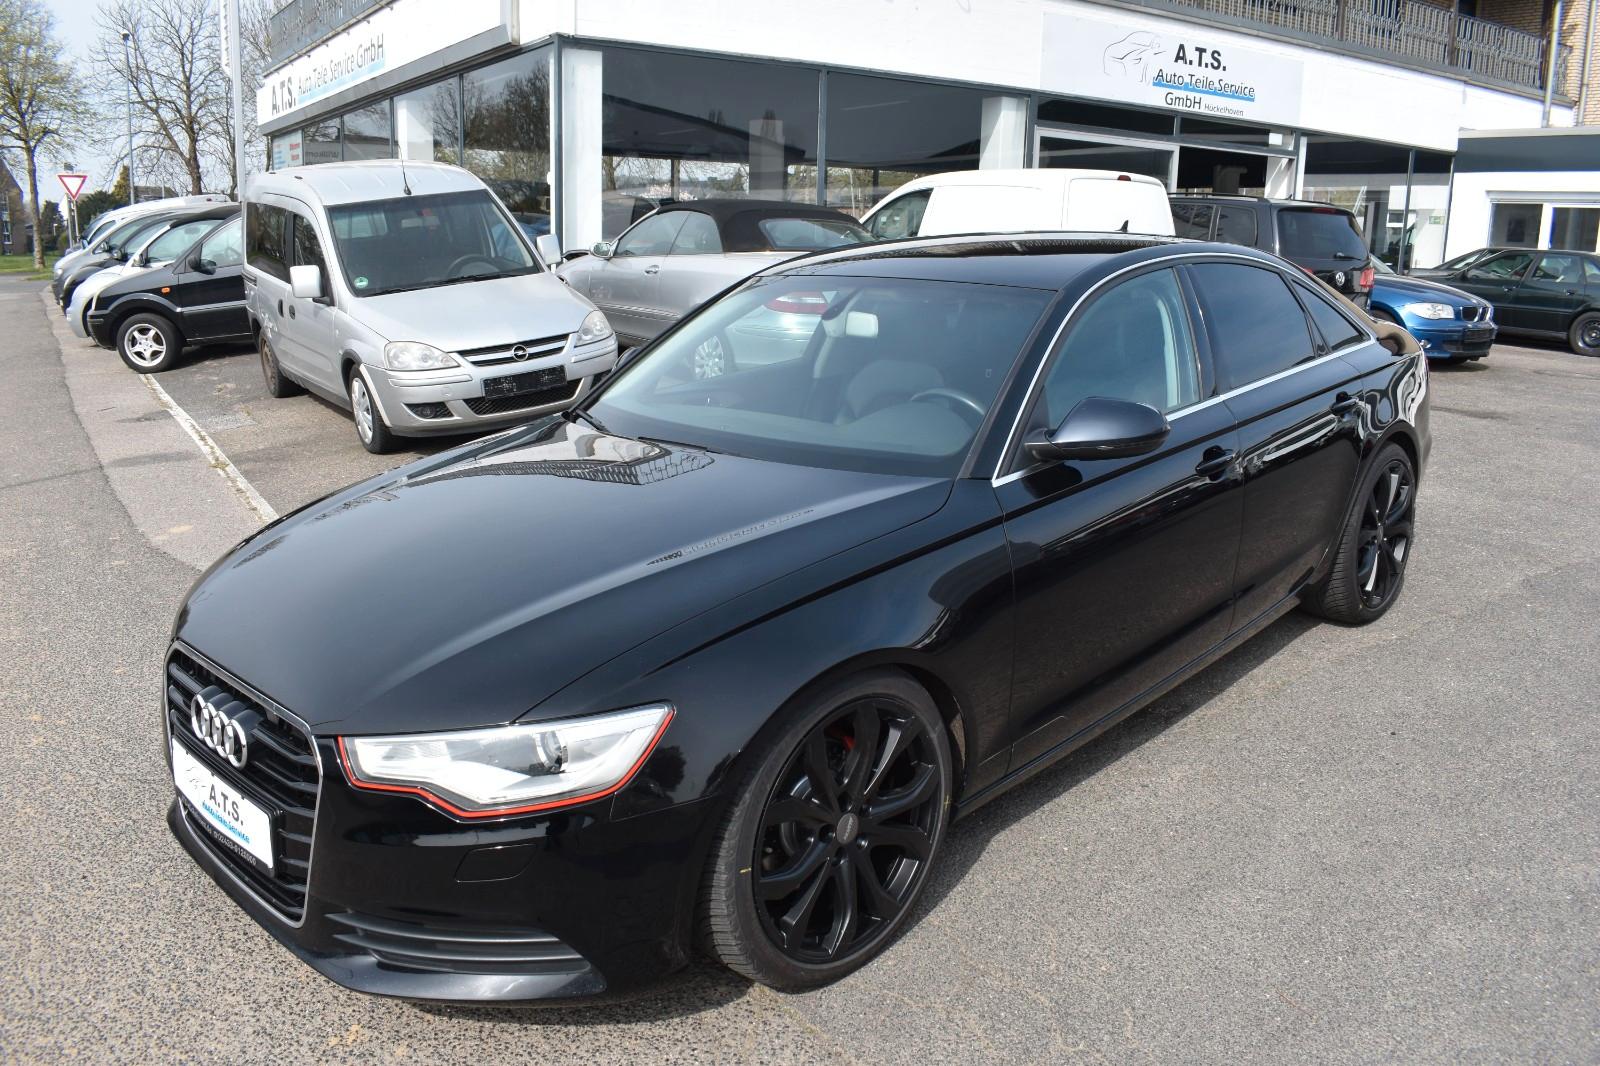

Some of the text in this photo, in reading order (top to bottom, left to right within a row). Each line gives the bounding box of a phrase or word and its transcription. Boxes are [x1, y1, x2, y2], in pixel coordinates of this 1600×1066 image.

[1174, 43, 1227, 72] A.T.S.
[271, 77, 296, 116] A.T.S.
[329, 52, 355, 82] Service
[356, 33, 384, 67] GmbH
[1155, 68, 1255, 98] Auto Teile Service
[1165, 91, 1202, 110] GmbH
[209, 784, 244, 826] A.T.S.
